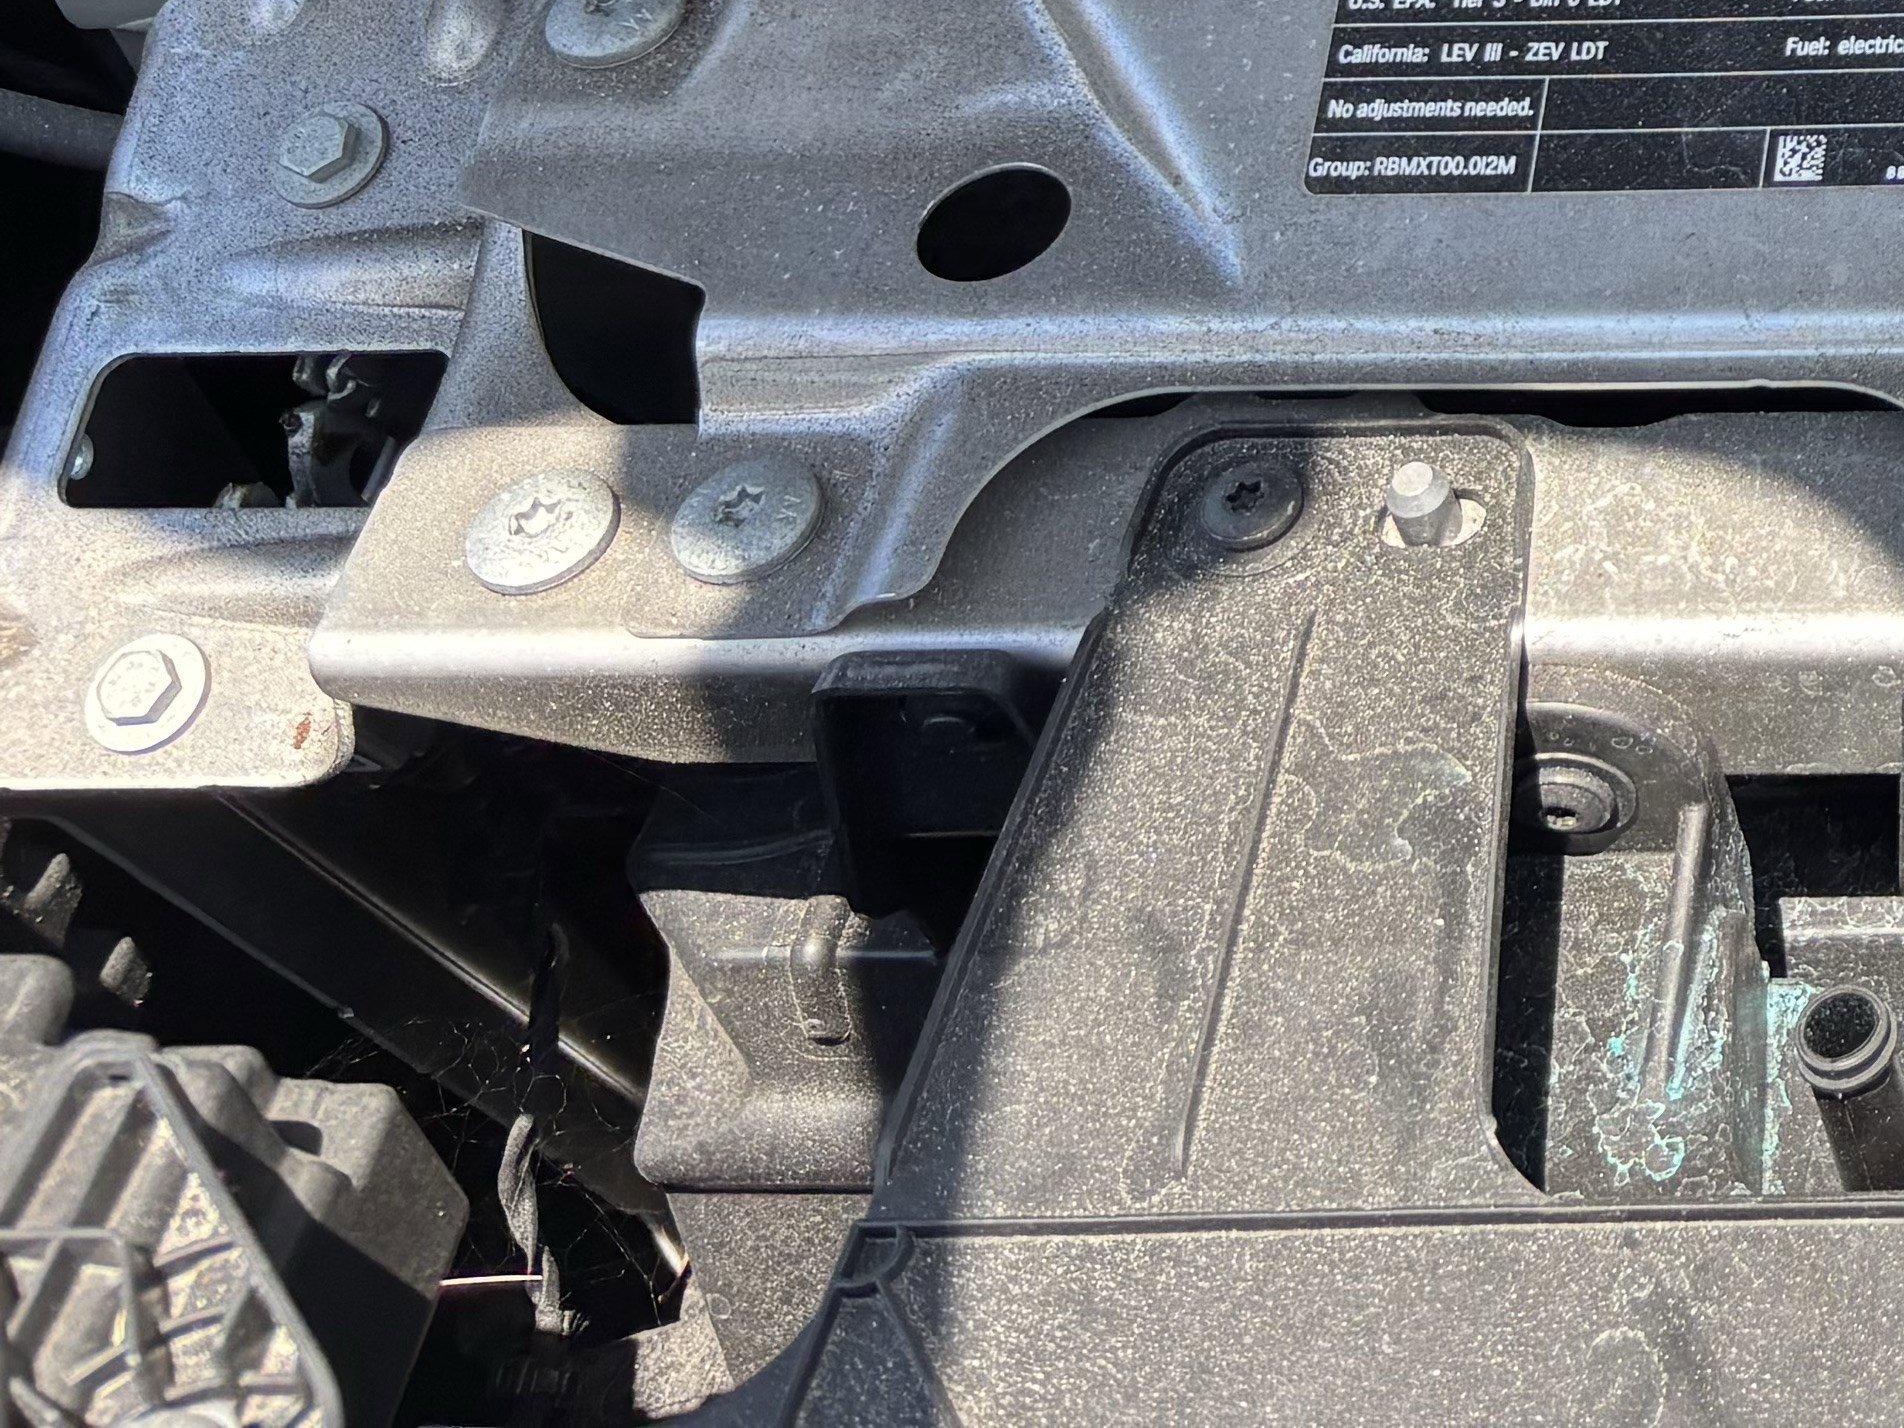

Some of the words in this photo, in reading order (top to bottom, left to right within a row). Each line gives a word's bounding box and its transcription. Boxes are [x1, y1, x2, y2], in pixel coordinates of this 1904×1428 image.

[1338, 44, 1431, 65] California:
[1440, 43, 1480, 63] LEV
[1484, 43, 1503, 62] III
[1524, 41, 1566, 62] ZEV
[1570, 40, 1610, 61] LDT
[1785, 36, 1831, 58] Fuel:
[1326, 100, 1355, 119] No
[1356, 97, 1462, 123] adjustments
[1464, 96, 1535, 118] needed.
[1308, 158, 1370, 180] Group:
